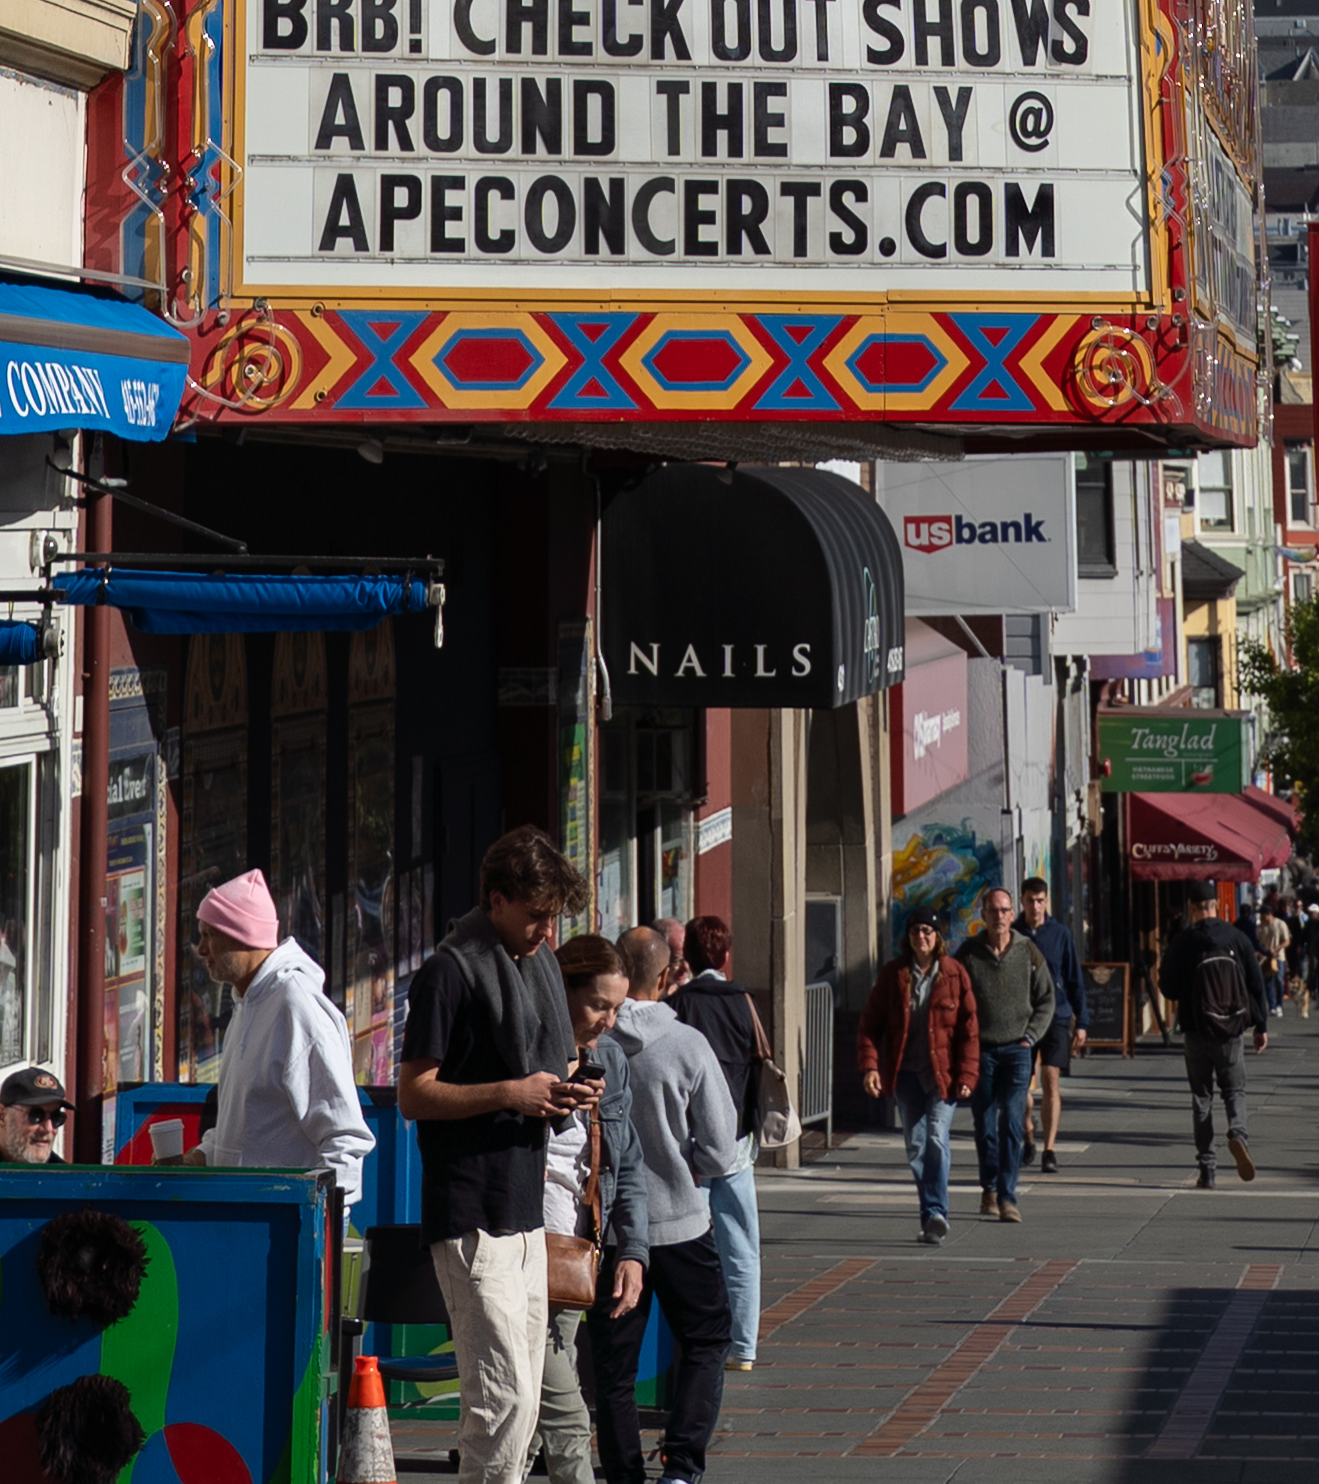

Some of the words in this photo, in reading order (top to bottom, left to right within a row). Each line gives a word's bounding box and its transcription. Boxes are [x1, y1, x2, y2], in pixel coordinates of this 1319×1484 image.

[314, 71, 617, 158] AROUND
[653, 79, 788, 160] THE
[828, 85, 974, 161] BAY
[1007, 90, 1056, 153] @
[318, 171, 1057, 259] APECONCERTS.COM
[6, 360, 111, 419] COMPANY
[627, 641, 812, 677] NAILS
[1131, 723, 1216, 758] Tanglad
